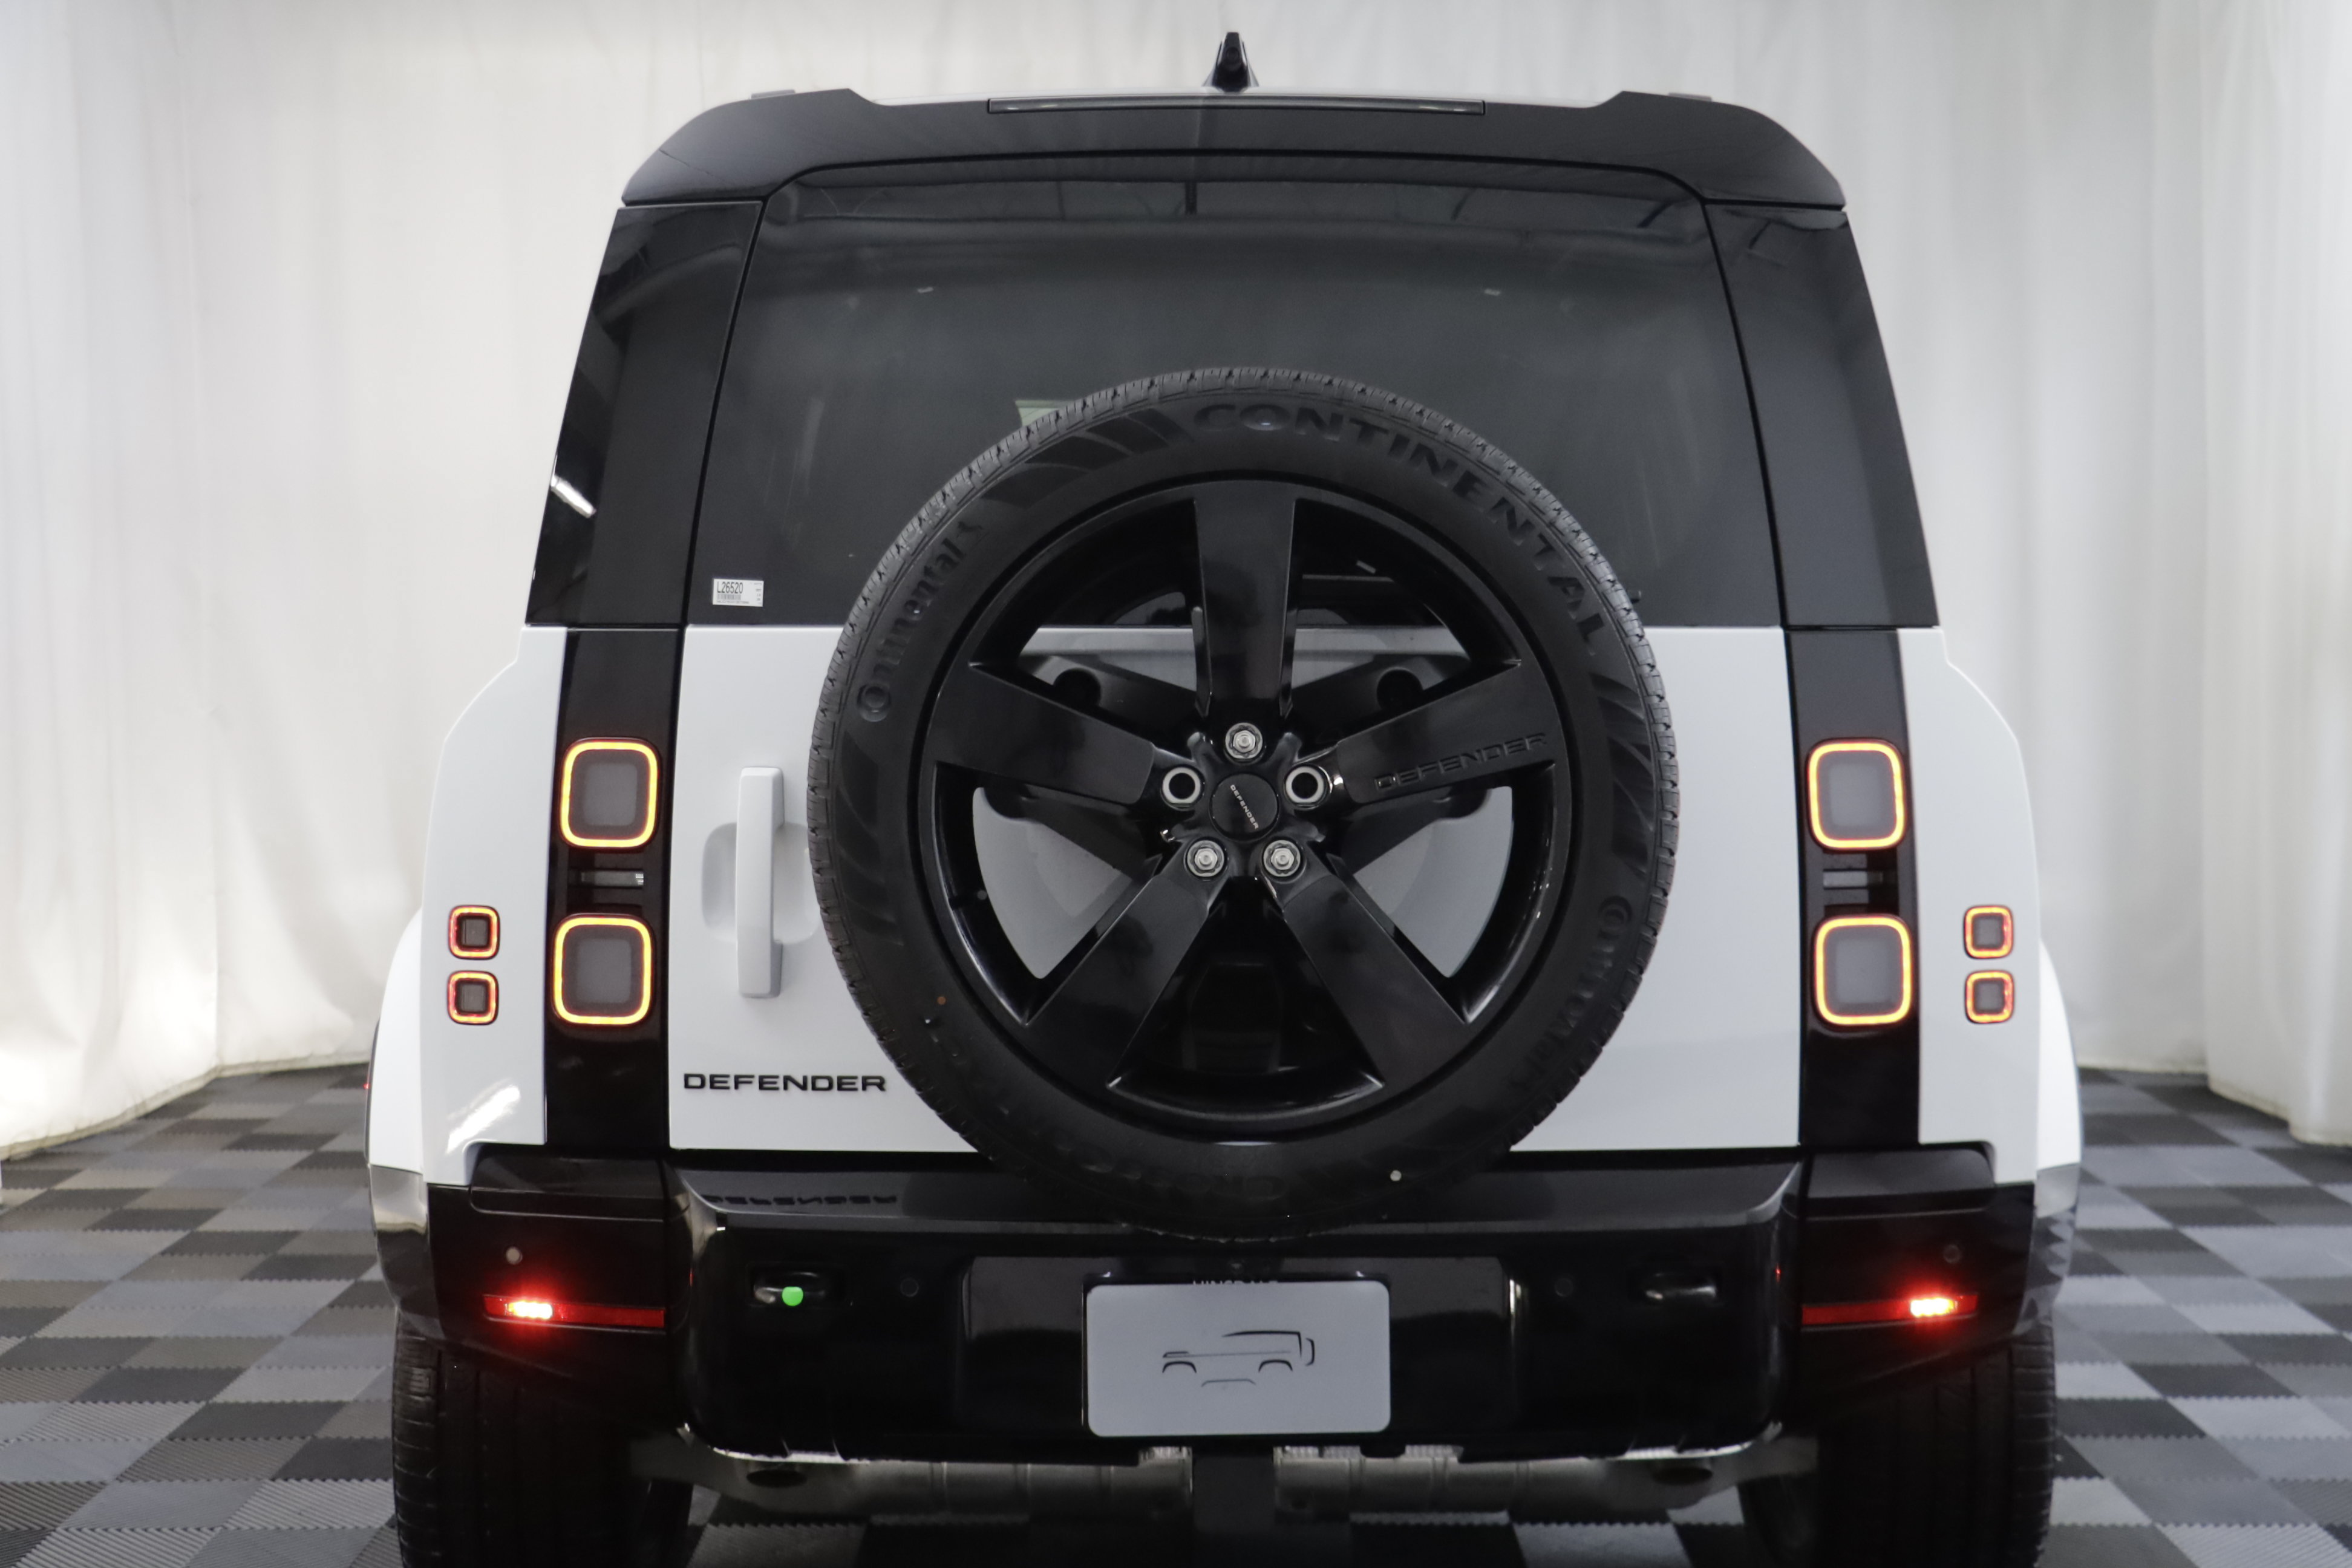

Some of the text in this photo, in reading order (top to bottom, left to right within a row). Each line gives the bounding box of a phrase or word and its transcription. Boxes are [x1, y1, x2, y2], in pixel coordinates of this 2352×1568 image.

[1193, 402, 1609, 657] CONTINENTAL
[716, 580, 743, 595] L26520
[1374, 733, 1547, 791] DEFENDER
[1230, 784, 1259, 829] DEFENDER
[684, 1073, 886, 1091] DEFENDER
